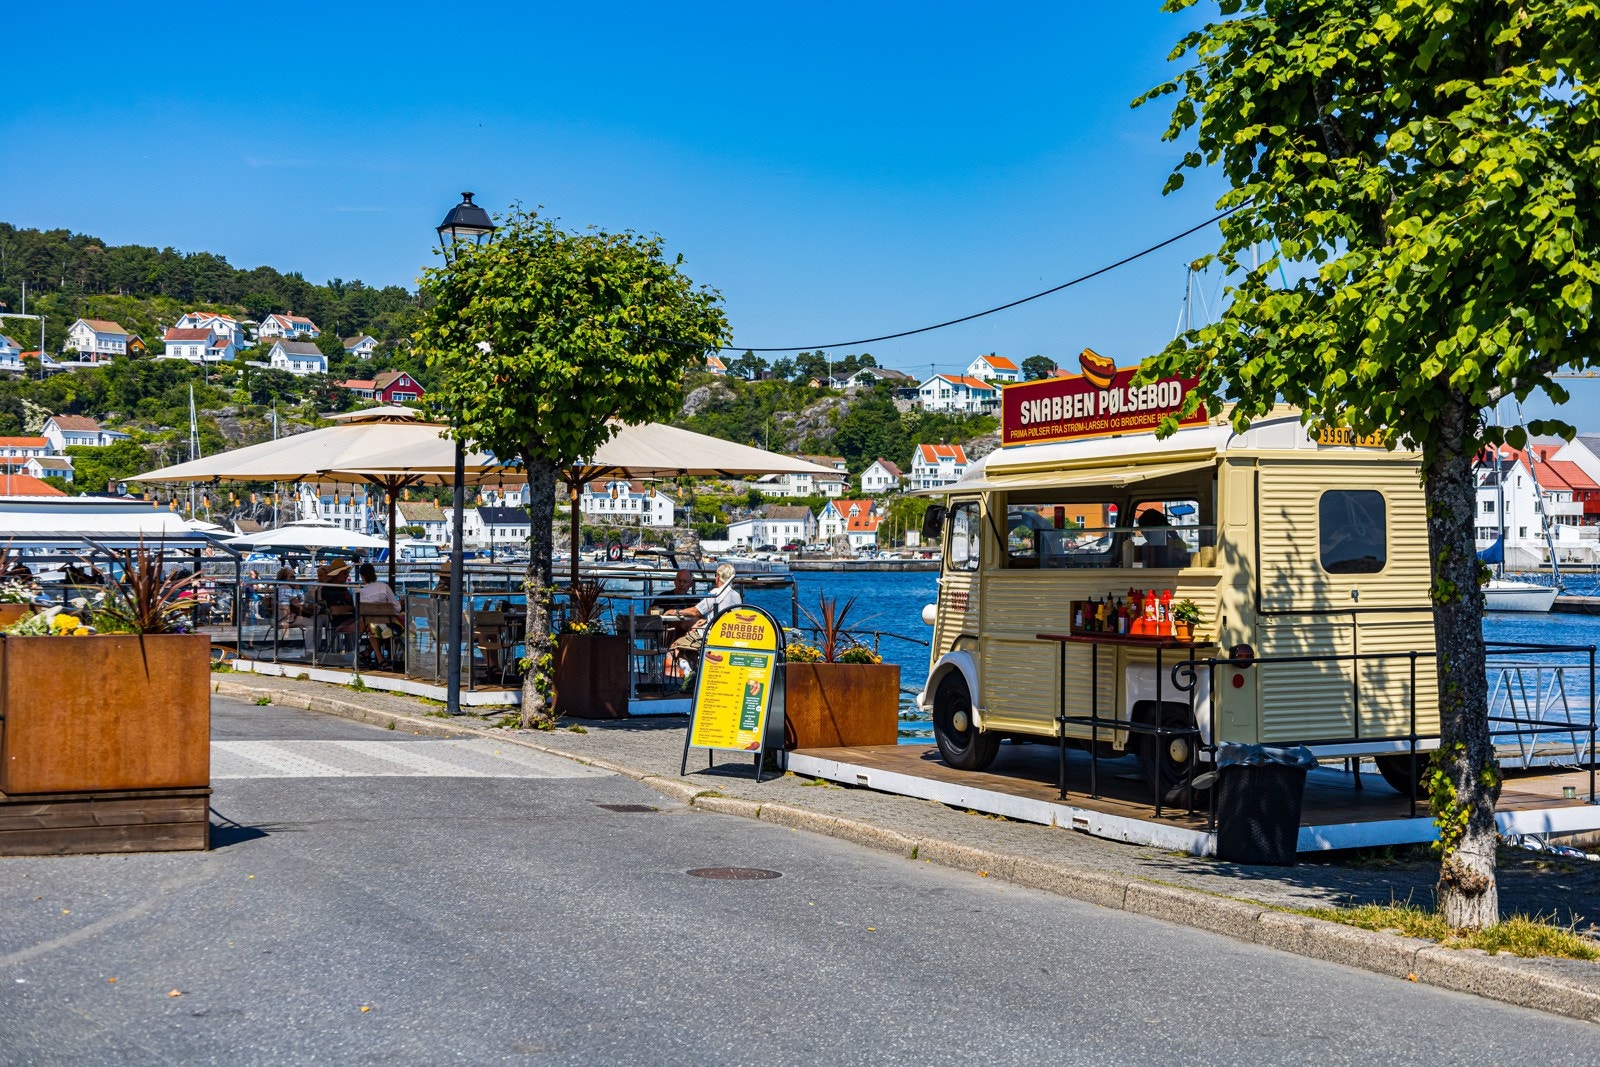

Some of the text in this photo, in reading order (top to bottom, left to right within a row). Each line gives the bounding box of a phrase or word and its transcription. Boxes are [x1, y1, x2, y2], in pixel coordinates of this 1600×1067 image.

[1020, 381, 1182, 425] SNABBEN PØLSEBOD
[1010, 428, 1028, 439] PRIMA
[1028, 426, 1051, 437] PØLSER
[1051, 425, 1063, 435] FRA
[1063, 419, 1109, 433] STRØM-LARSEN
[1110, 418, 1120, 428] OG
[1121, 413, 1156, 427] BRØDRENE
[721, 622, 765, 633] SNABBEN
